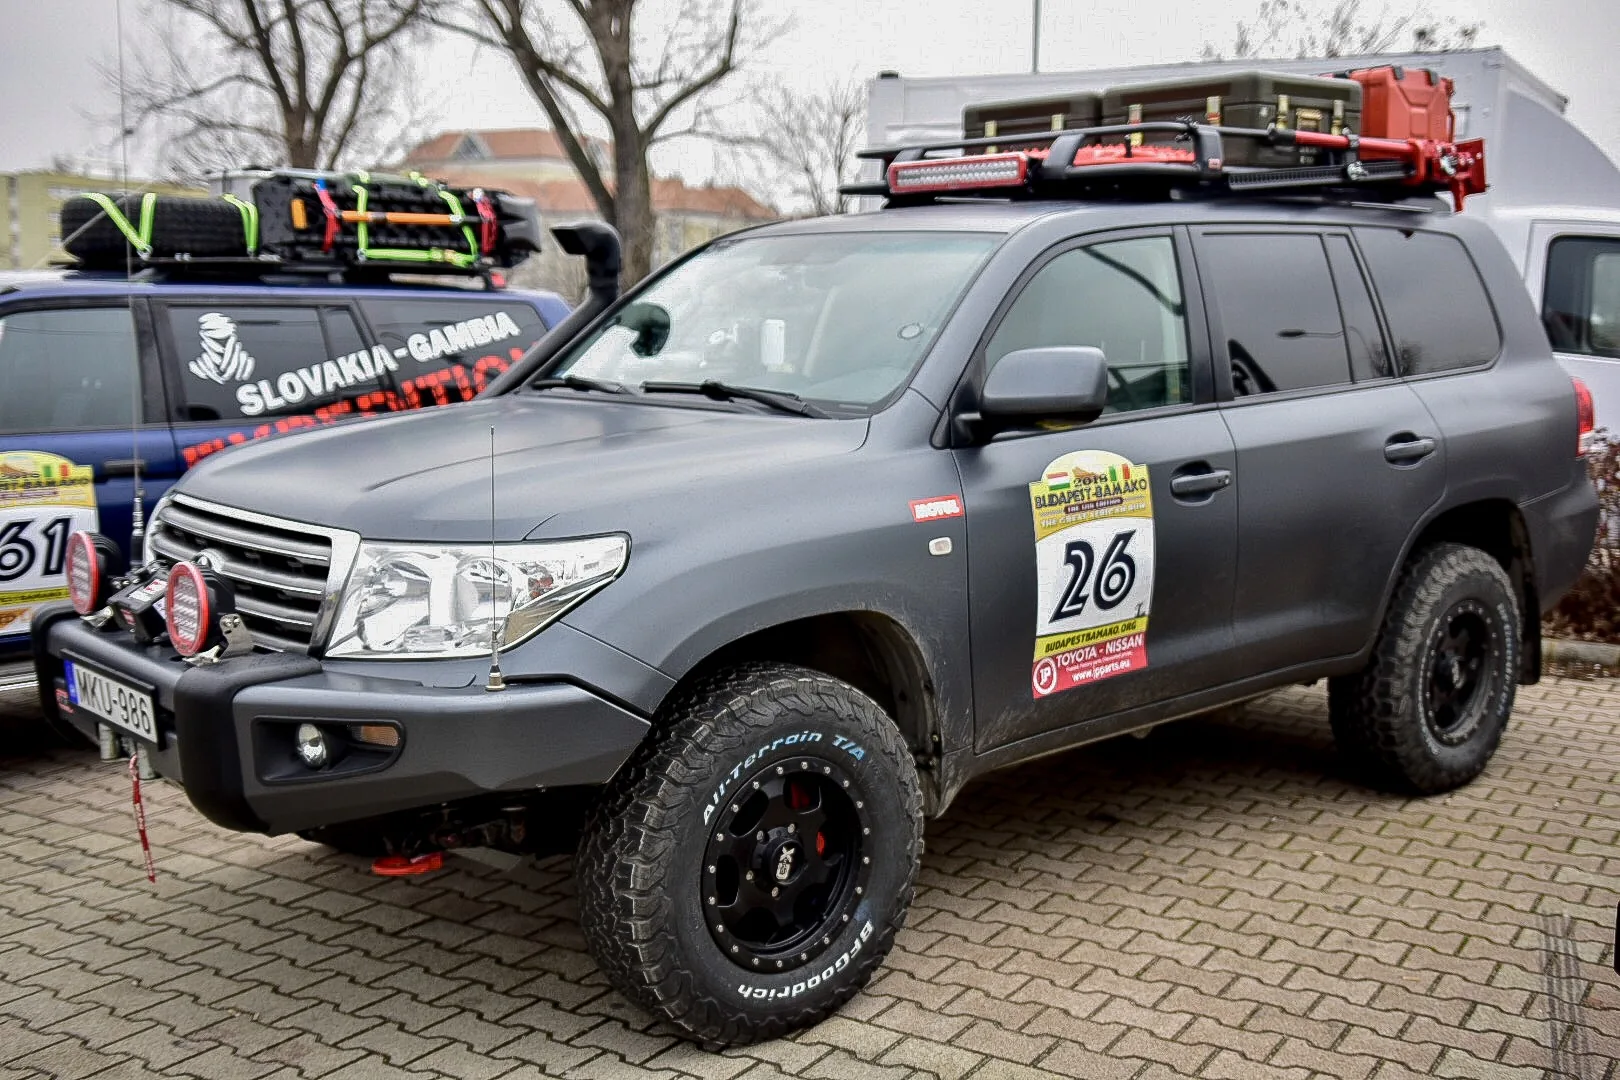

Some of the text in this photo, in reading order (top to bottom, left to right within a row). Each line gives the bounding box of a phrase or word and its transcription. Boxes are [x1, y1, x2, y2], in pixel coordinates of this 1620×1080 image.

[236, 311, 521, 416] SLOVAKIA-GAMBIA
[1035, 479, 1147, 509] BUDAPEST-BAMAKO
[1049, 529, 1136, 624] 26
[1056, 646, 1097, 667] TOYOTA
[1105, 634, 1143, 655] NISSAN
[738, 920, 874, 1001] BFGoodrich
